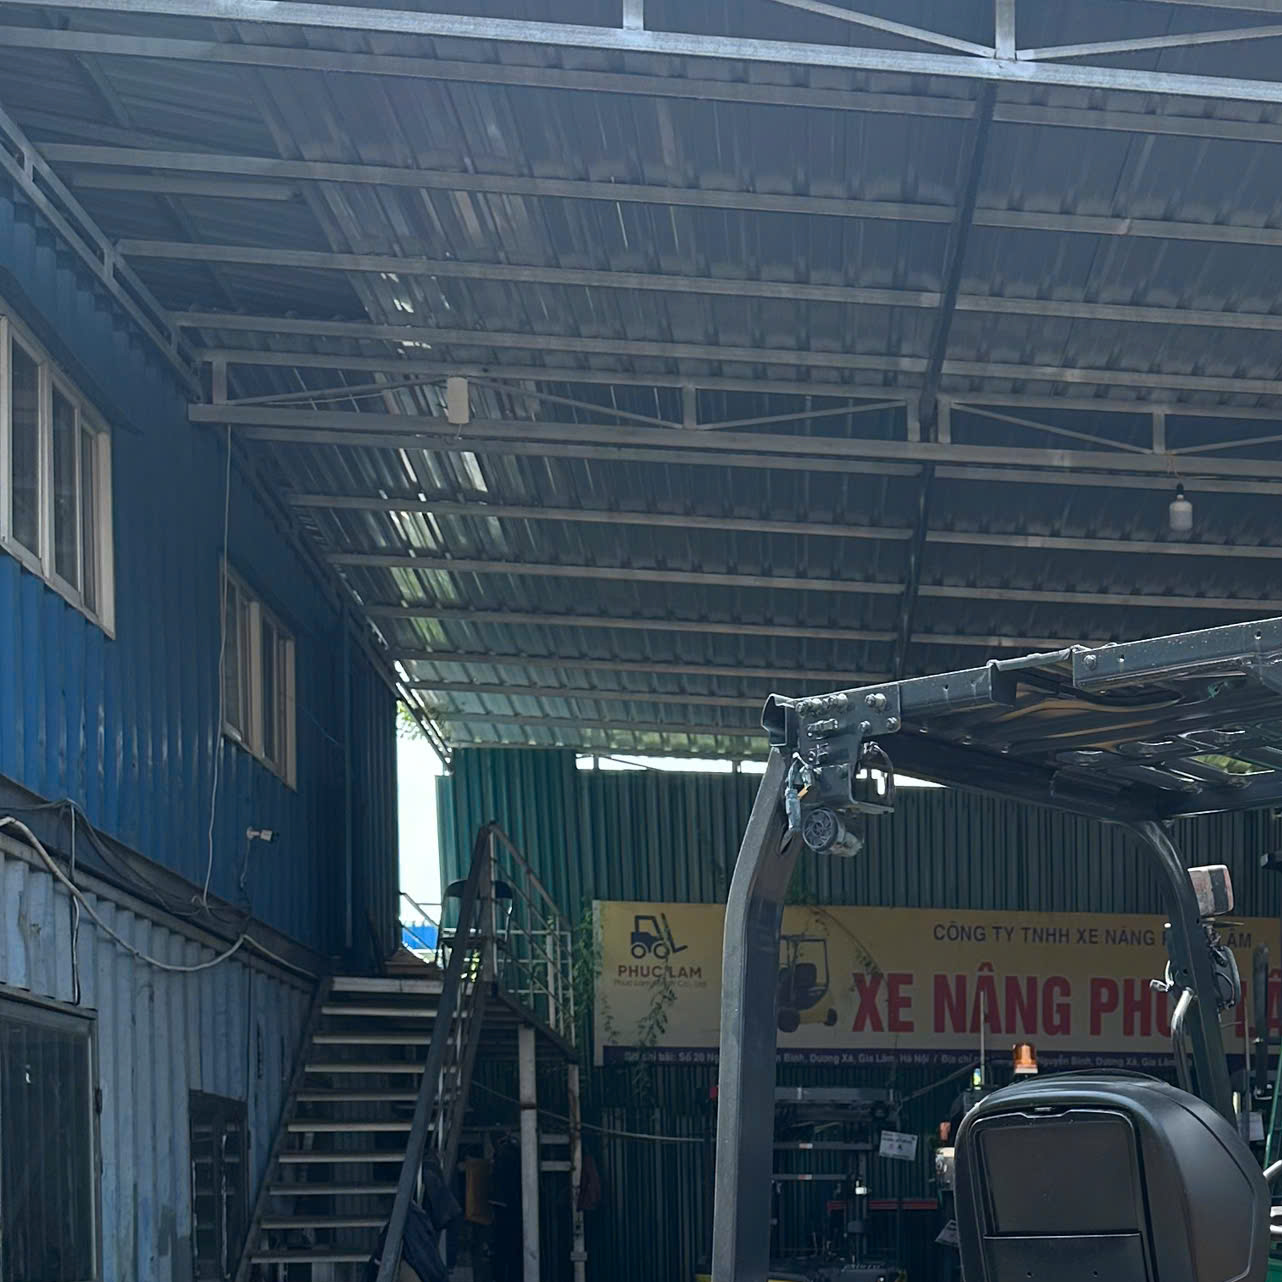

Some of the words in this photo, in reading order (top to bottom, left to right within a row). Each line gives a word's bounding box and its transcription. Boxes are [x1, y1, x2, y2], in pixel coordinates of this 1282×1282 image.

[933, 921, 987, 942] CÔNG
[992, 926, 1014, 941] TY
[1021, 928, 1071, 944] TNHH
[1076, 929, 1100, 944] XE
[1104, 926, 1156, 945] NÂNG
[1227, 928, 1253, 948] ÂM
[618, 965, 662, 978] PHUC
[669, 966, 703, 979] LAM
[852, 972, 916, 1033] XE
[933, 961, 1072, 1036] NÂNG
[859, 1053, 873, 1064] Gia
[1038, 1053, 1070, 1068] guyễn
